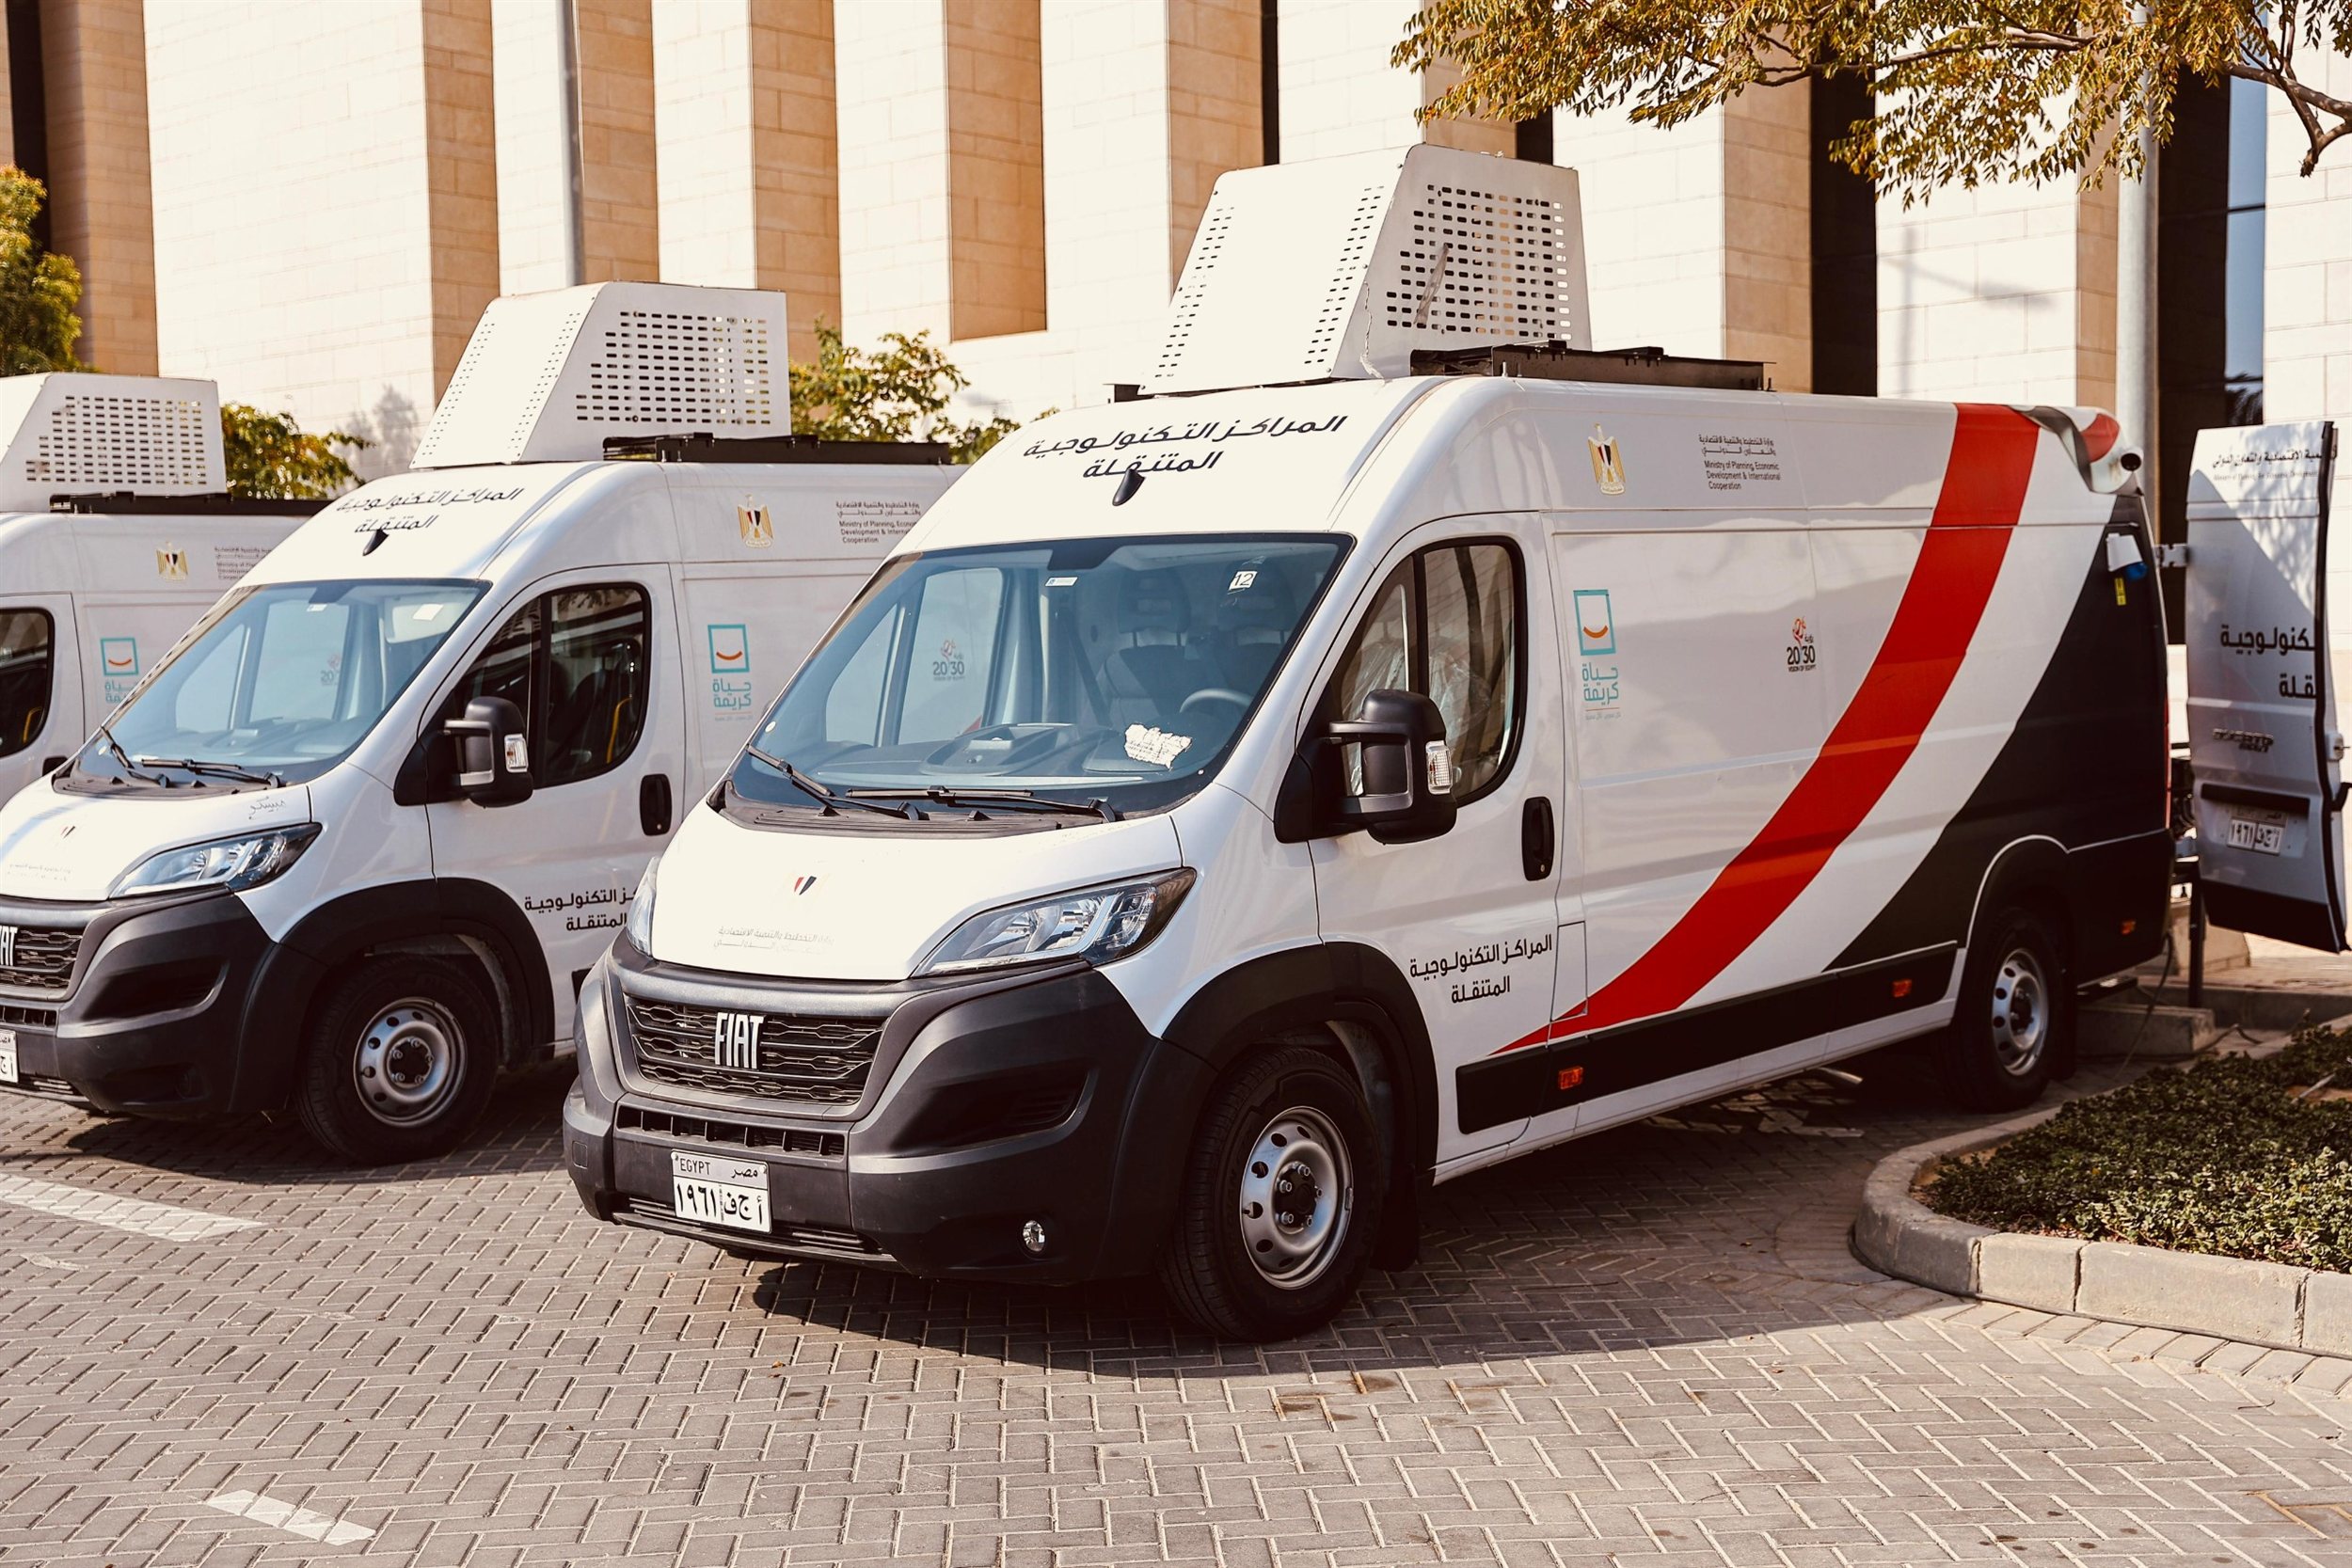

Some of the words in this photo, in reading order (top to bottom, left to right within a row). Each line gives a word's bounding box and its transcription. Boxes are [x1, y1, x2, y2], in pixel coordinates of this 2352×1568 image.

[1024, 422, 1220, 459] التكنولوجية
[1212, 416, 1348, 442] المراكز
[1083, 451, 1224, 478] المتنقلة
[1704, 460, 1725, 470] Ministry
[1725, 461, 1731, 469] of
[1755, 462, 1780, 470] Economic
[1706, 470, 1742, 481] Development
[1748, 472, 1781, 481] International
[442, 488, 524, 506] المراكز
[1708, 481, 1741, 490] Cooperation
[337, 490, 452, 513] التكنولوجية
[354, 515, 438, 532] المتنقلة
[1233, 572, 1254, 586] 12
[2220, 625, 2315, 656] كنولوجية
[1581, 662, 1618, 686] حياة
[712, 678, 752, 696] حياة
[1583, 681, 1619, 705] كريمة
[713, 692, 752, 710] كريمة
[525, 889, 617, 913] التكنولوجية
[566, 912, 628, 931] المتنقلة
[0, 926, 18, 966] AT
[1502, 934, 1552, 964] المراكز
[1410, 943, 1500, 981] التكنولوجية
[1451, 975, 1511, 1004] المتنقلة
[715, 1012, 764, 1069] FIAT
[679, 1158, 711, 1176] EGYPT
[731, 1168, 758, 1179] مصر
[677, 1183, 717, 1218] ١٩٦١
